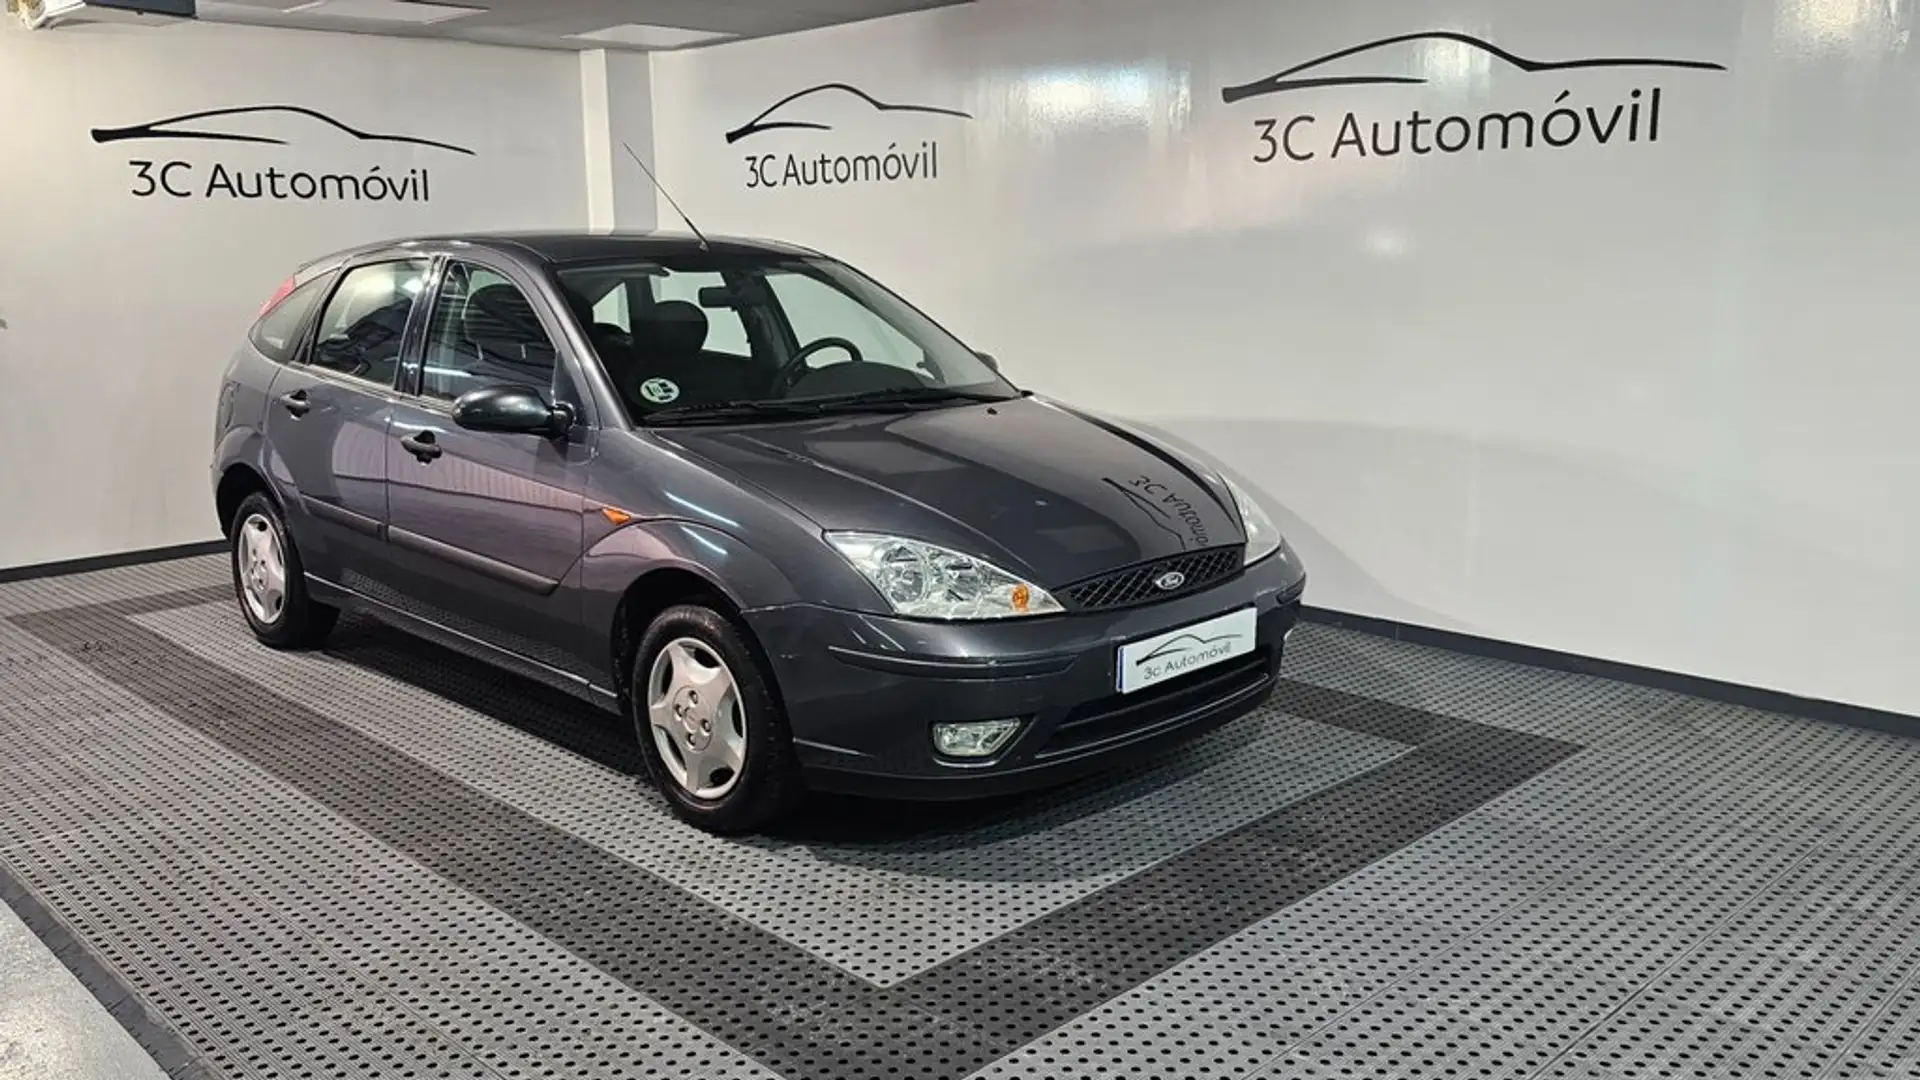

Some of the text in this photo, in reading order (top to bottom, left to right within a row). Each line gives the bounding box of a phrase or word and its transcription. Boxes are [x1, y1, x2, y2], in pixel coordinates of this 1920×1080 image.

[1254, 88, 1661, 162] 3C Automóvil
[130, 161, 429, 201] 3C Automóvil
[746, 142, 937, 188] 3C Automóvil
[1165, 641, 1231, 672] Automóvil
